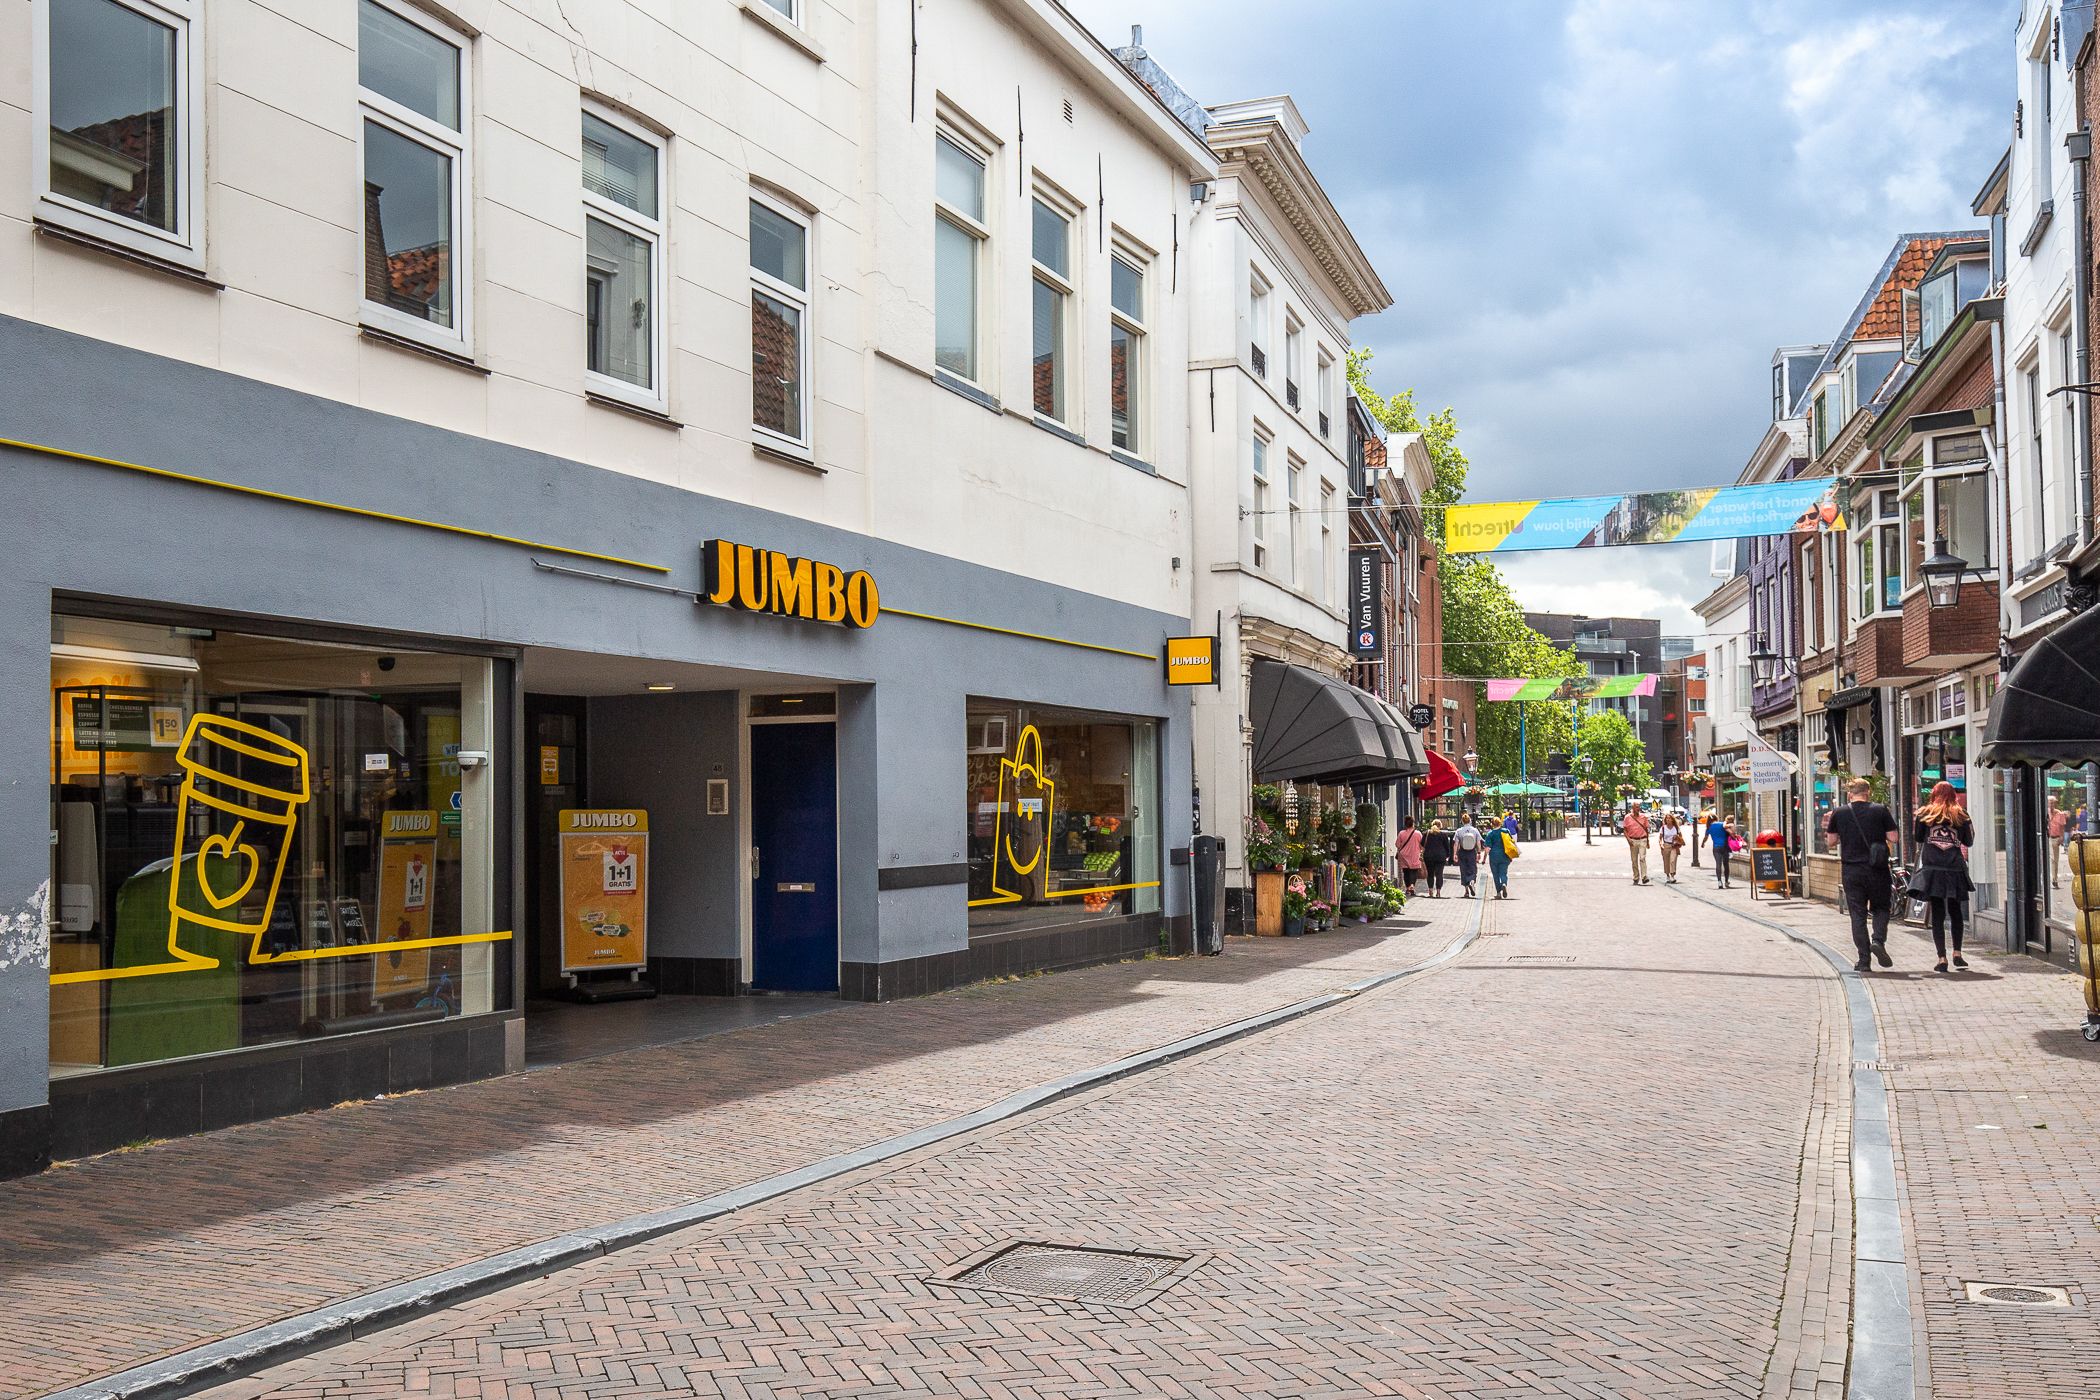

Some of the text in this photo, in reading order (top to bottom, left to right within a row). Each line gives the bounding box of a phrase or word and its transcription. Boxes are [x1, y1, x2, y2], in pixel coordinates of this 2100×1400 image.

[706, 539, 880, 629] JUMBO
[1360, 556, 1371, 629] Van Vuuren
[1170, 655, 1210, 666] JUMBO
[1753, 771, 1780, 780] Kleding
[389, 814, 431, 832] JUMBO
[571, 813, 637, 828] JUMBO
[609, 865, 632, 881] 1+1
[409, 877, 424, 896] 1+1
